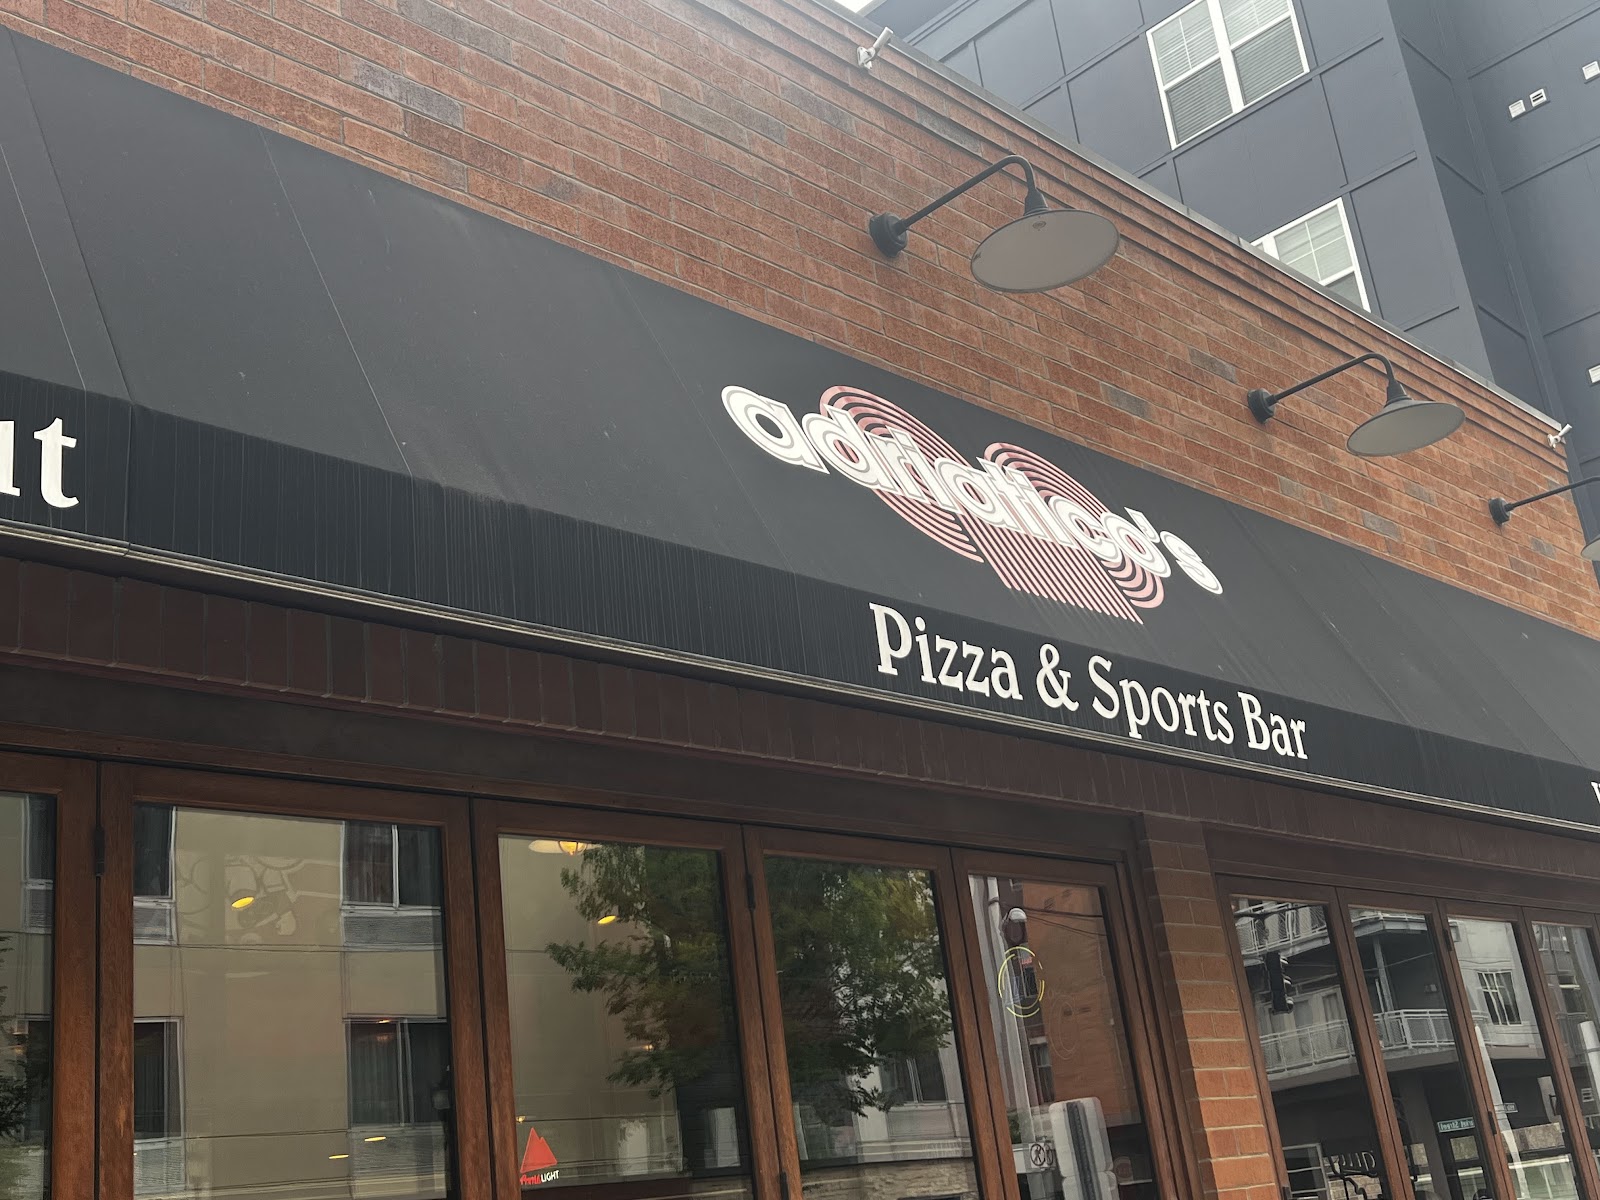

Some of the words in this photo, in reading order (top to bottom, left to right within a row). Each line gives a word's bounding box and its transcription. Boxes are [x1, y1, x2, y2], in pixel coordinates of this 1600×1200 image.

[721, 385, 1223, 595] adriatico's
[869, 602, 1024, 701] Pizza
[1036, 643, 1080, 712] &
[1088, 655, 1235, 745] Sports
[1237, 691, 1309, 760] Bar
[541, 1169, 560, 1183] LIGHT
